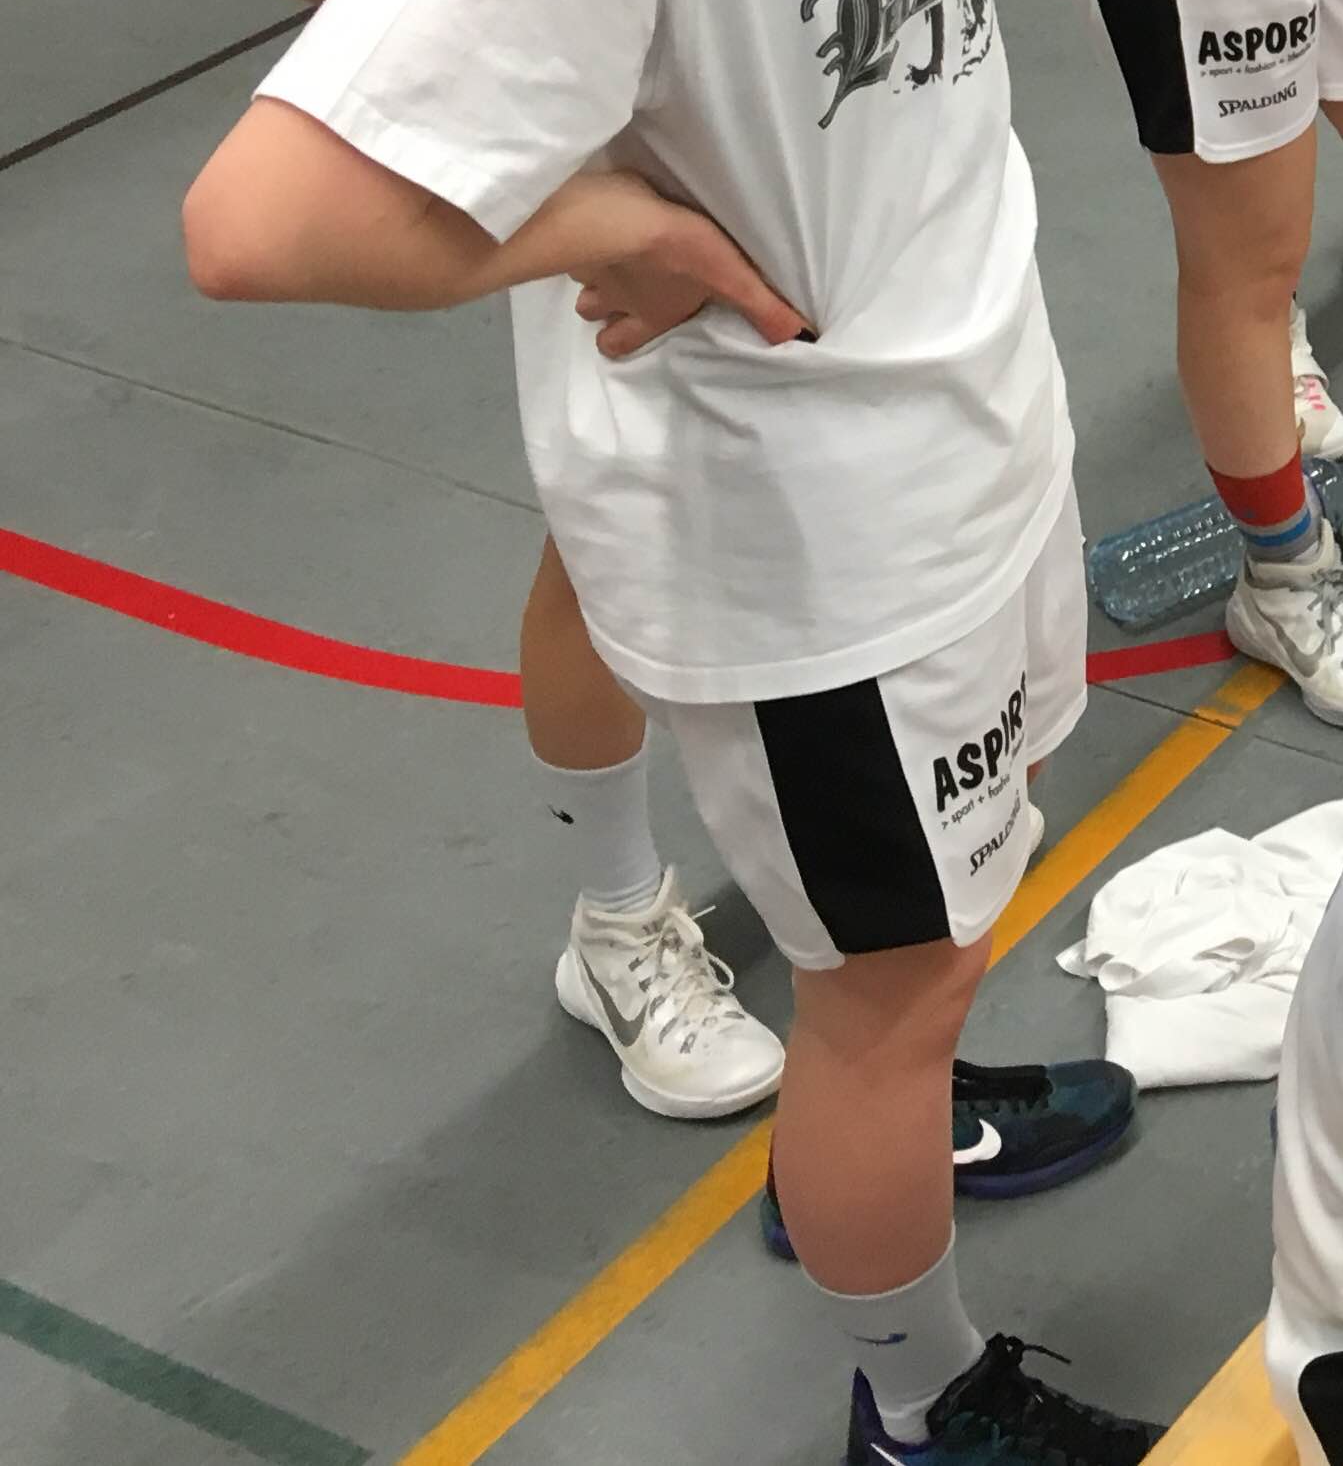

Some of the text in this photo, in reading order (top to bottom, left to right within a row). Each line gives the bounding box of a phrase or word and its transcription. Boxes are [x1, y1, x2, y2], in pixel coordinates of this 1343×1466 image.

[1197, 3, 1318, 66] ASPORT
[1217, 80, 1299, 119] SPALDING
[951, 798, 976, 826] sport
